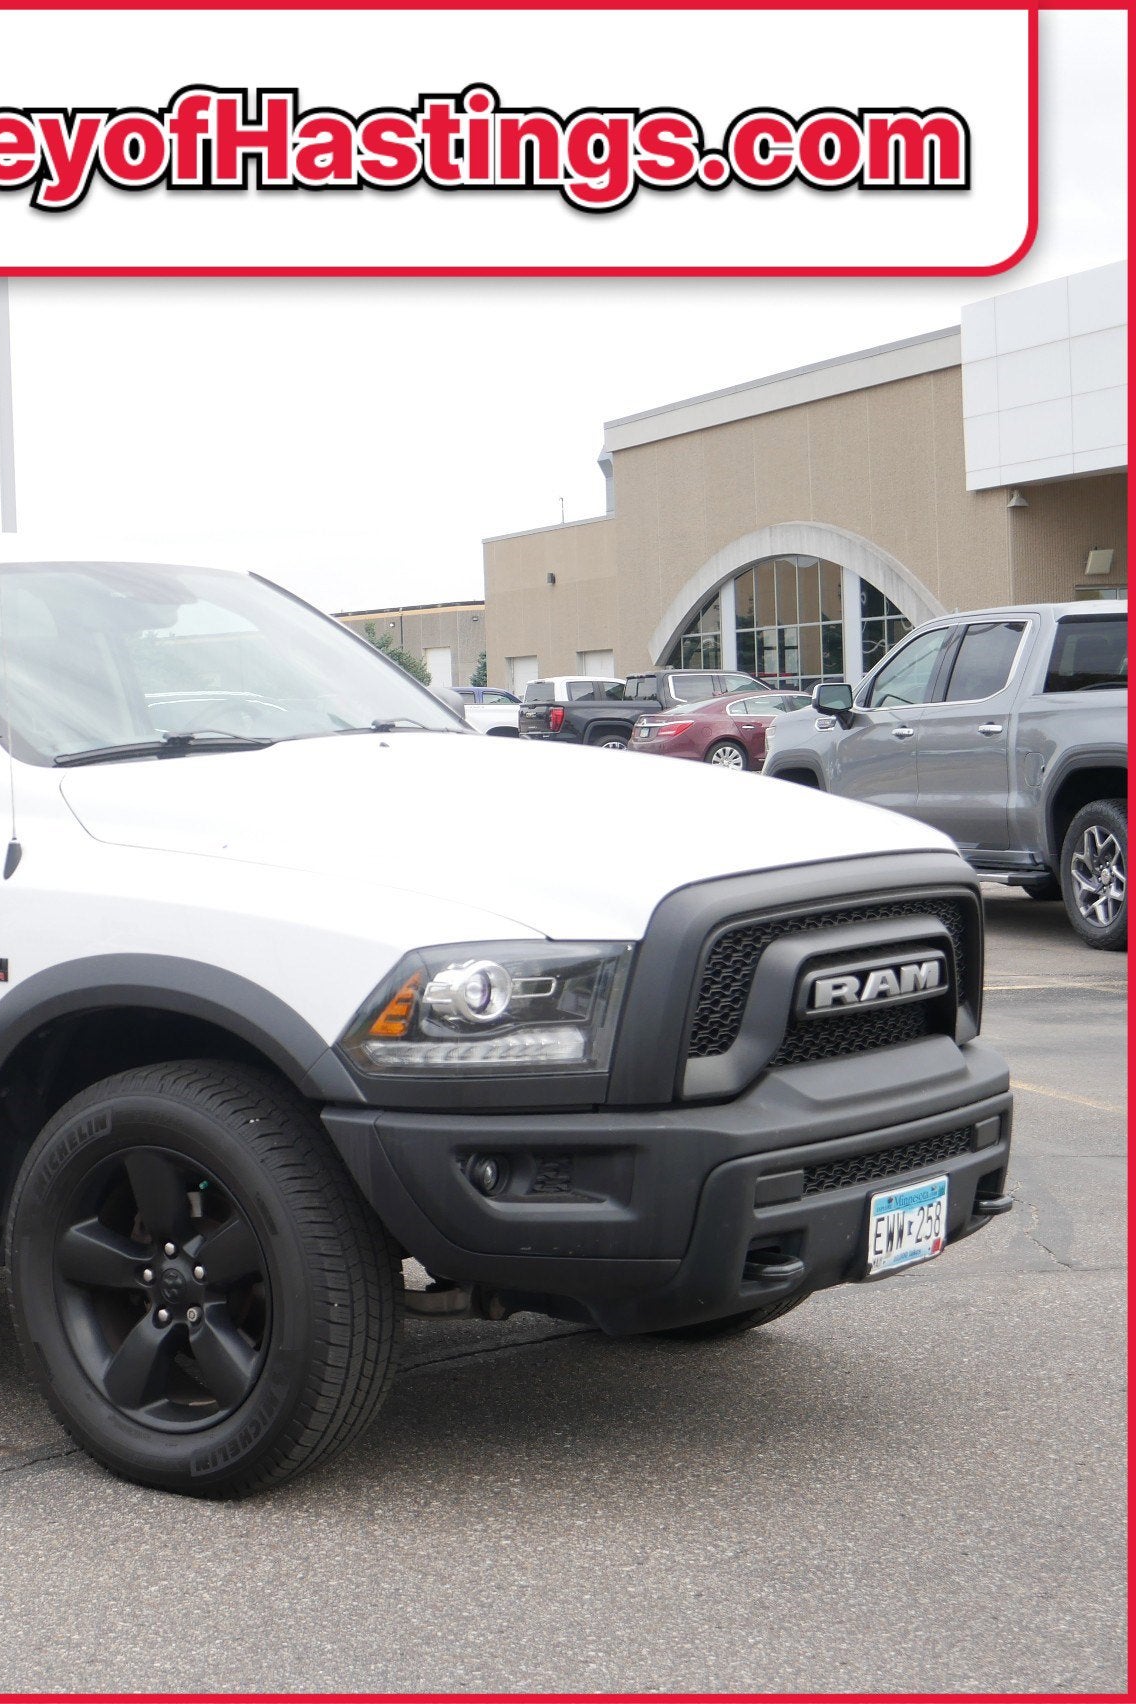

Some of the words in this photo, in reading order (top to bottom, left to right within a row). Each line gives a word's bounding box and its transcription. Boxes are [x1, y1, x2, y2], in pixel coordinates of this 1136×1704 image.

[815, 960, 939, 1009] RAM
[894, 1191, 929, 1207] Minnesota
[874, 1212, 905, 1255] EWW
[915, 1201, 941, 1243] 258
